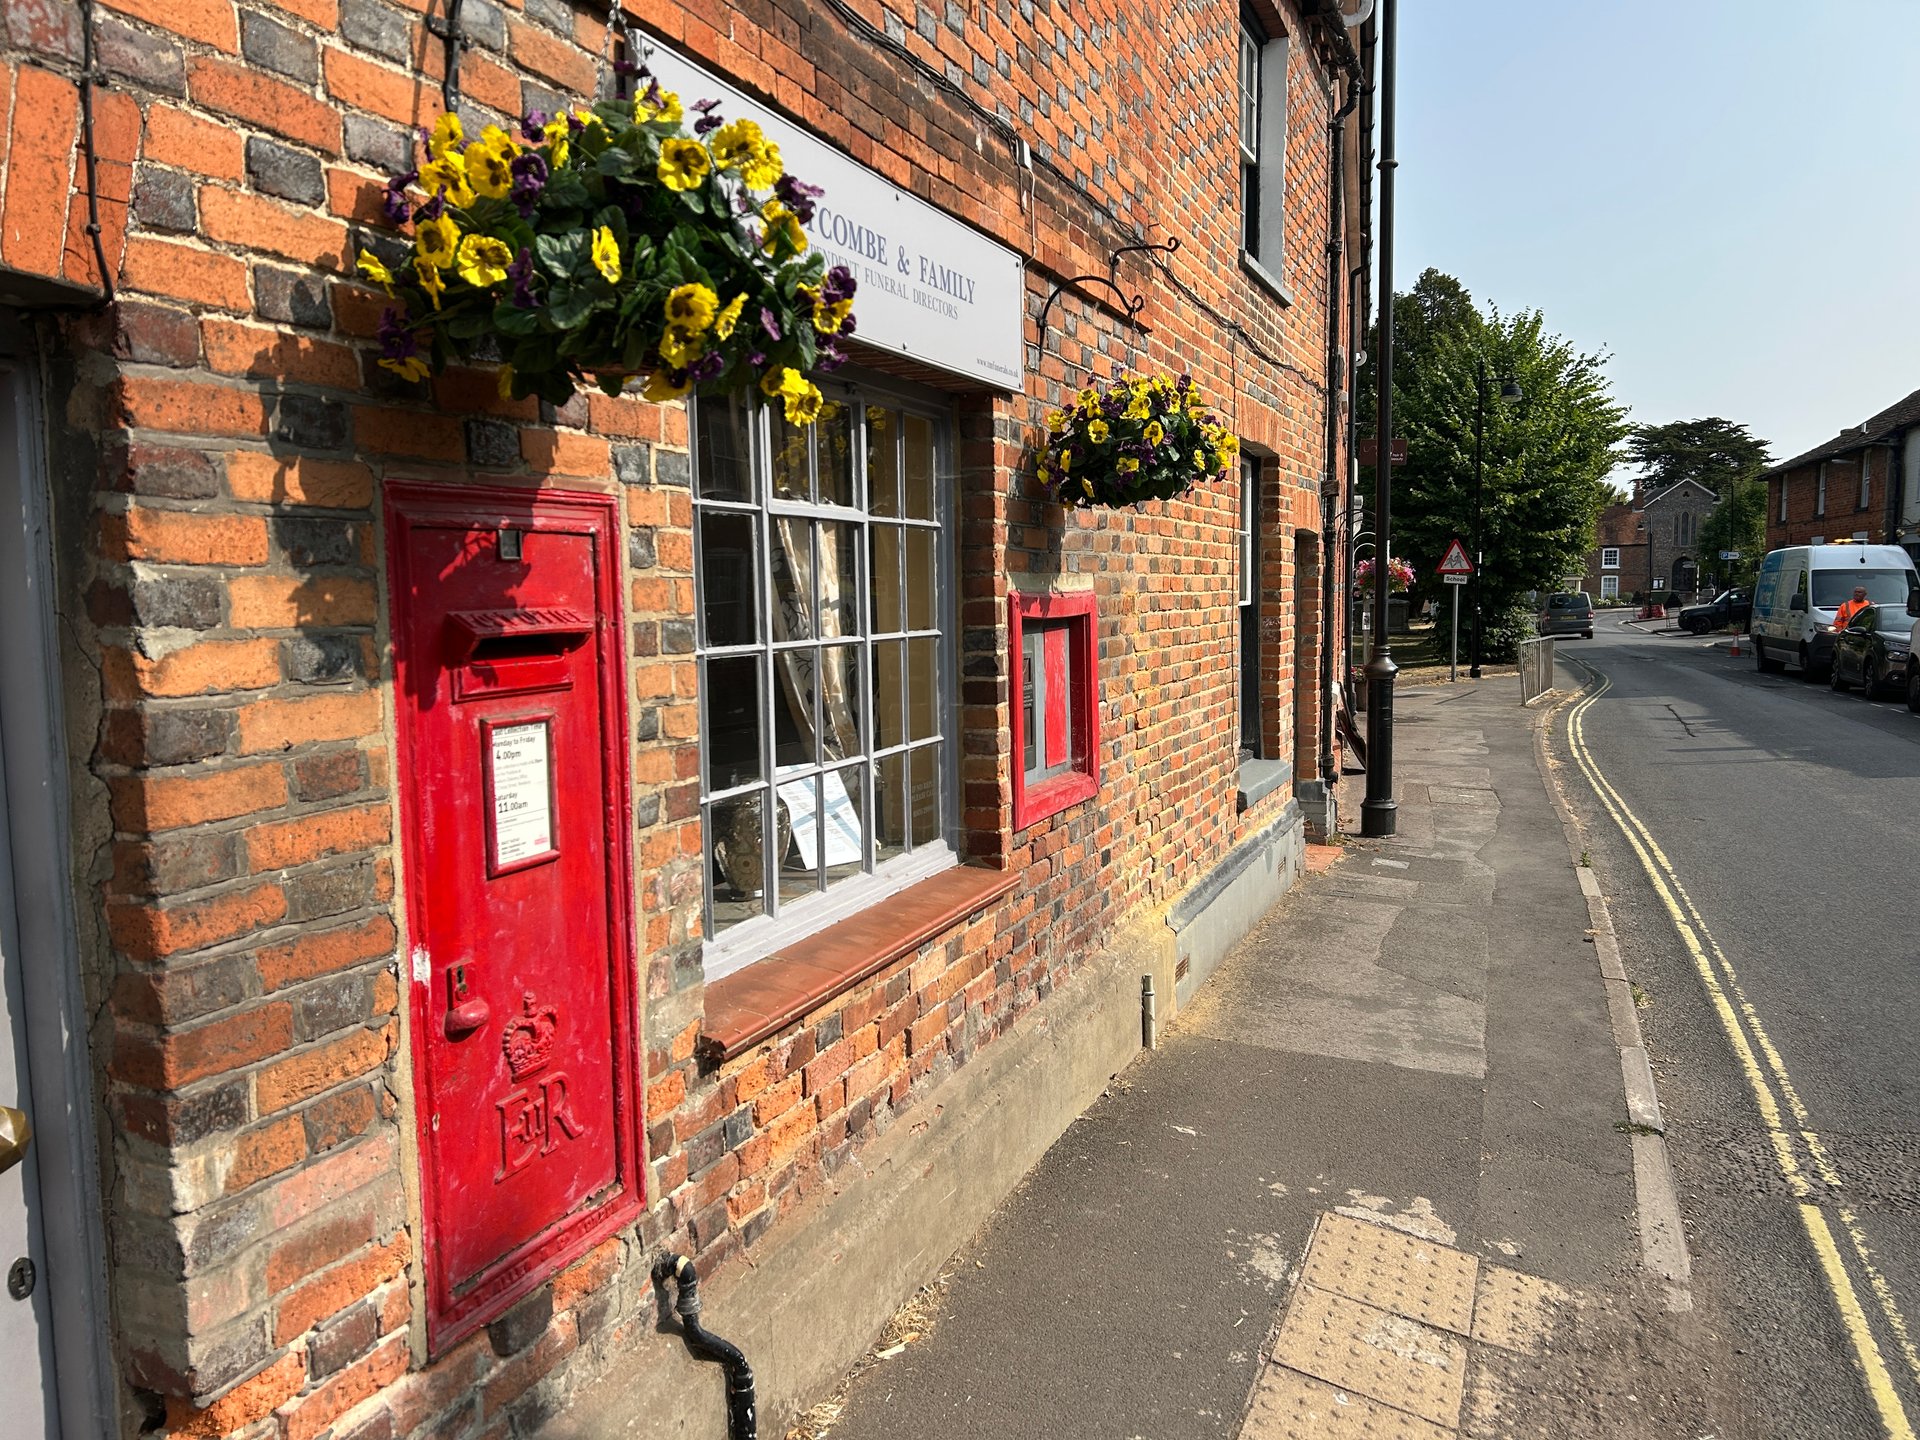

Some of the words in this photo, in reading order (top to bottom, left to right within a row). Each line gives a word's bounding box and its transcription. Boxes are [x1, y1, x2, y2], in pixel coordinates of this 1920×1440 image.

[897, 245, 910, 276] &
[918, 254, 976, 305] FAMILY
[864, 267, 909, 301] FUNERAL
[913, 288, 959, 320] DIRECTORS
[1446, 575, 1466, 583] School
[520, 735, 536, 745] Friday
[495, 749, 522, 761] 4.00pm
[495, 791, 518, 801] aturday
[498, 801, 529, 814] 11.00am
